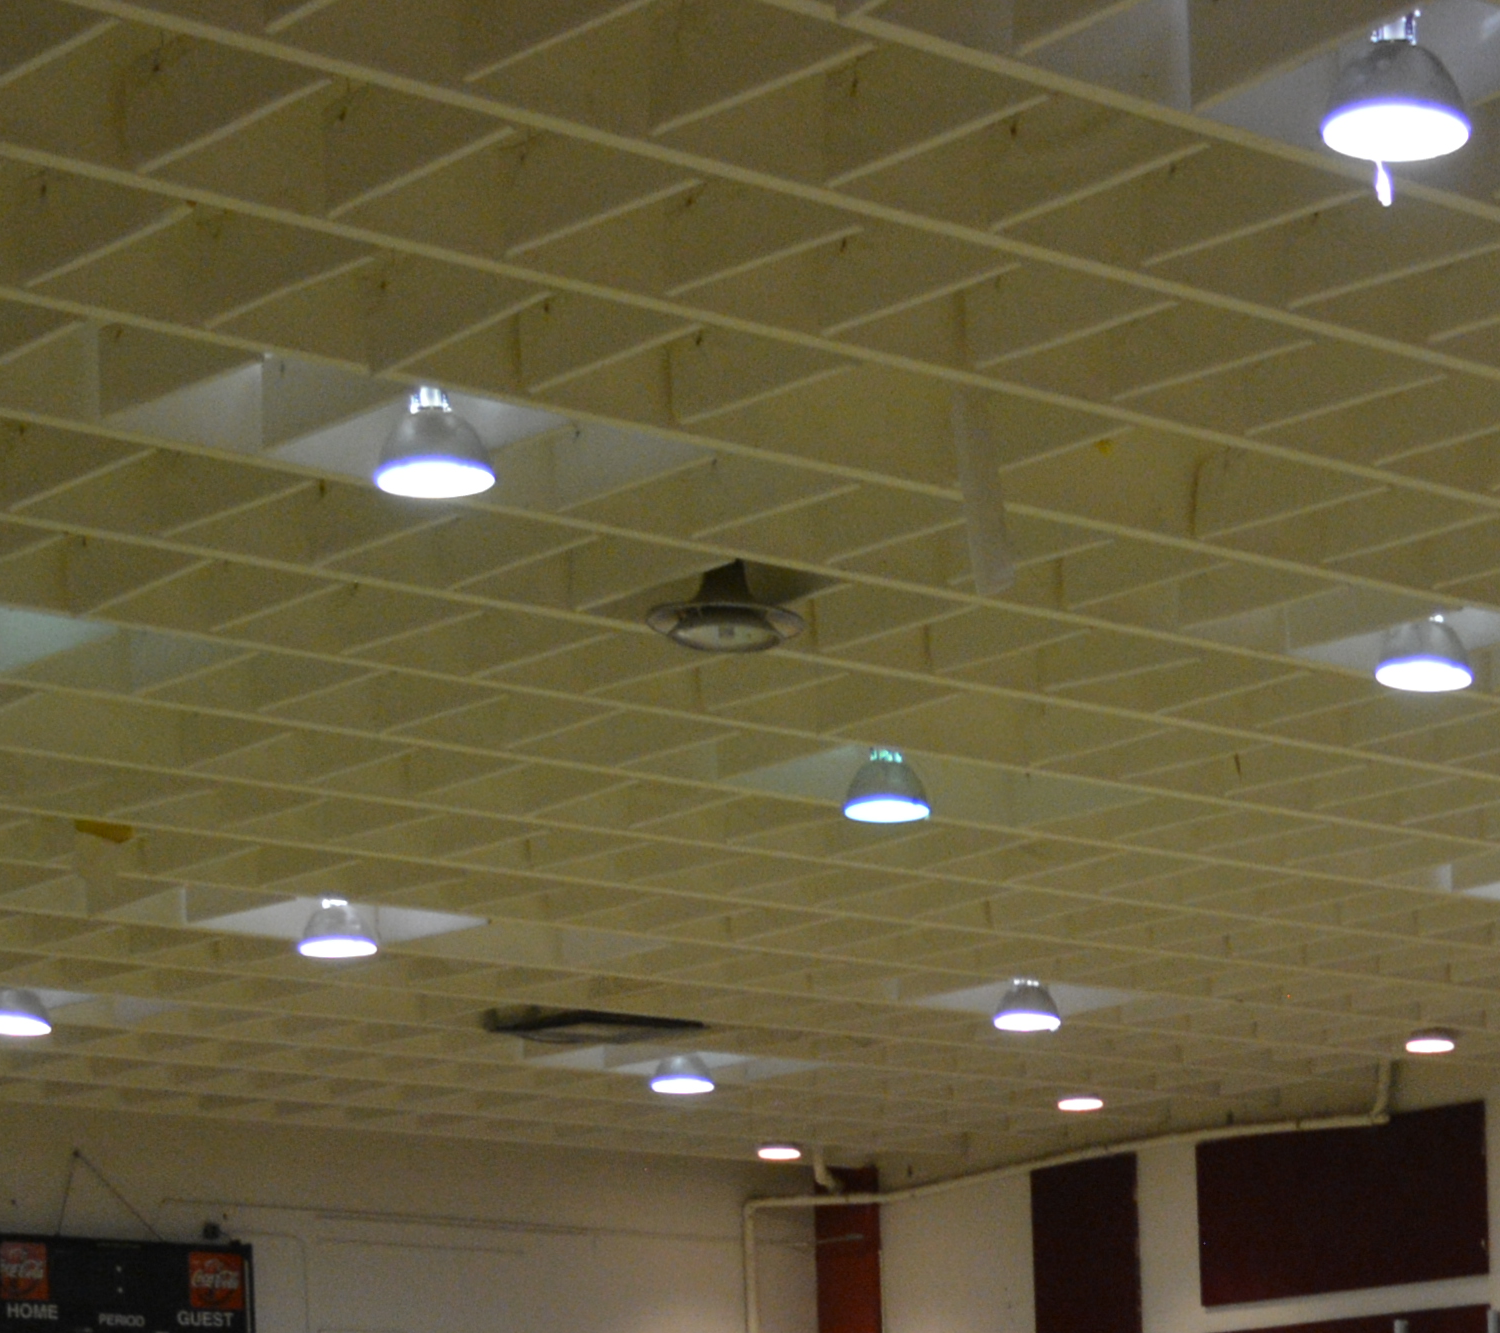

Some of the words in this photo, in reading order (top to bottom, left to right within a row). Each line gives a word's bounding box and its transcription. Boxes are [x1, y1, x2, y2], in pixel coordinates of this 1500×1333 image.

[6, 1303, 59, 1320] HOME
[176, 1310, 235, 1327] GUEST
[98, 1313, 146, 1328] PERIOD
